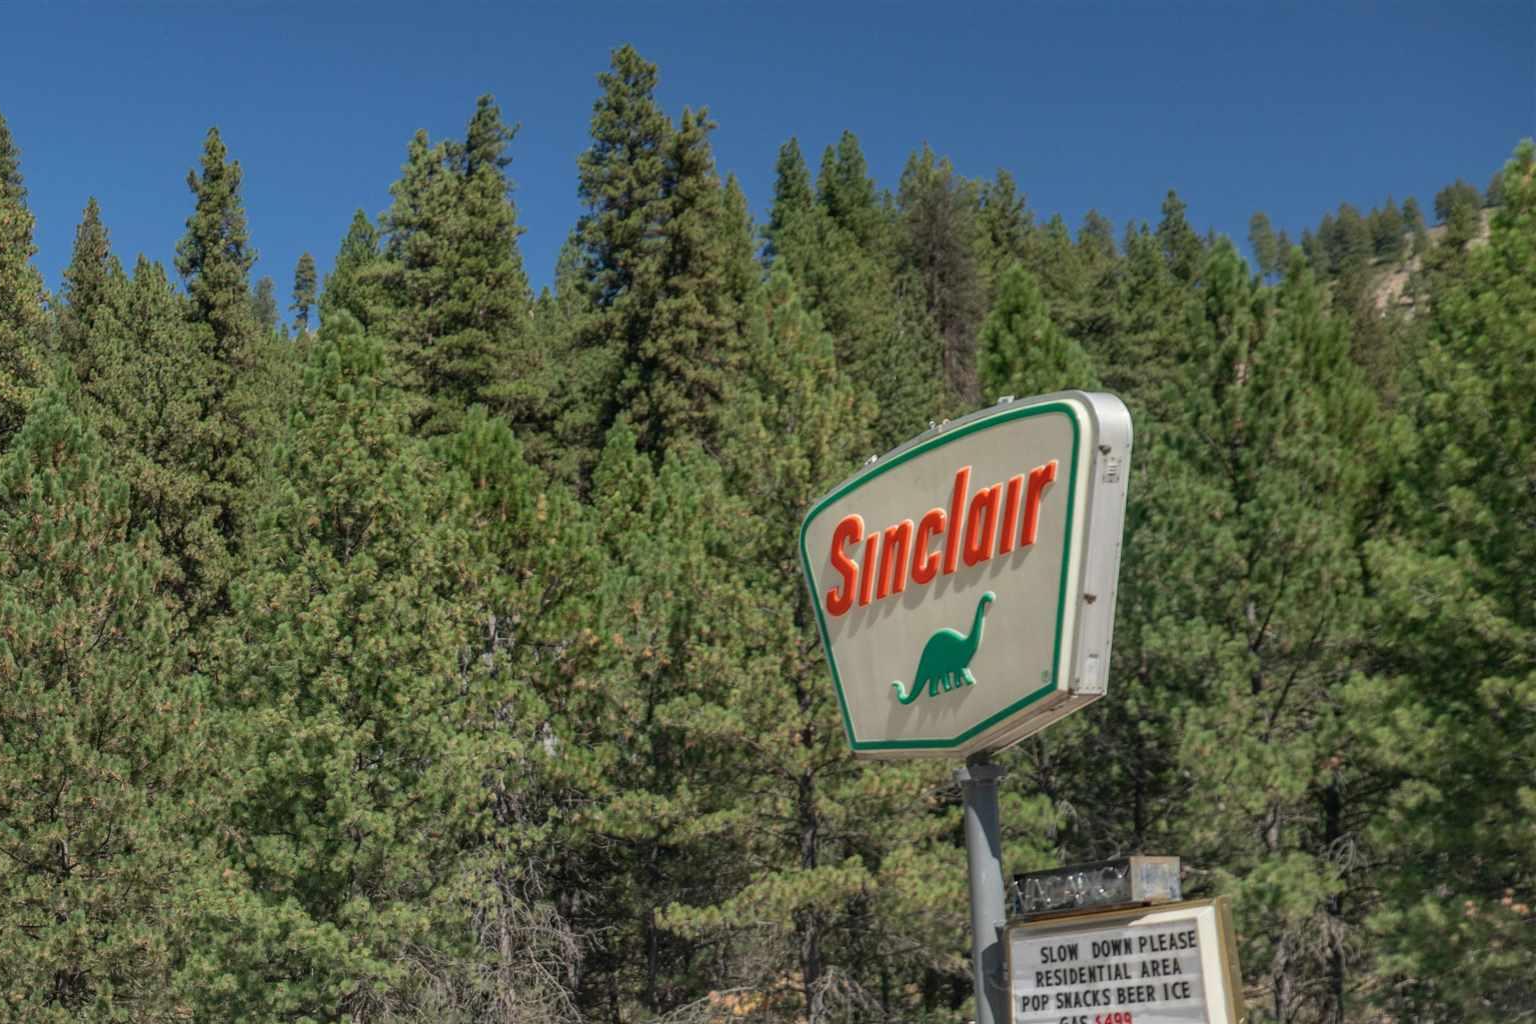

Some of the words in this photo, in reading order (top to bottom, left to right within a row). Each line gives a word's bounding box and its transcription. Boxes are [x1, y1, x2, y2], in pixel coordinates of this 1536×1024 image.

[826, 459, 1058, 617] Sinclair
[1040, 943, 1078, 964] SLOW
[1092, 936, 1133, 959] DOWN
[1138, 930, 1197, 953] PLEASE
[1035, 961, 1131, 988] RESIDENTIAL
[1140, 957, 1182, 978] AREA
[1022, 994, 1049, 1012] POP
[1056, 988, 1111, 1009] SNACKS
[1117, 985, 1155, 1005] BEER
[1163, 981, 1191, 1001] ICE
